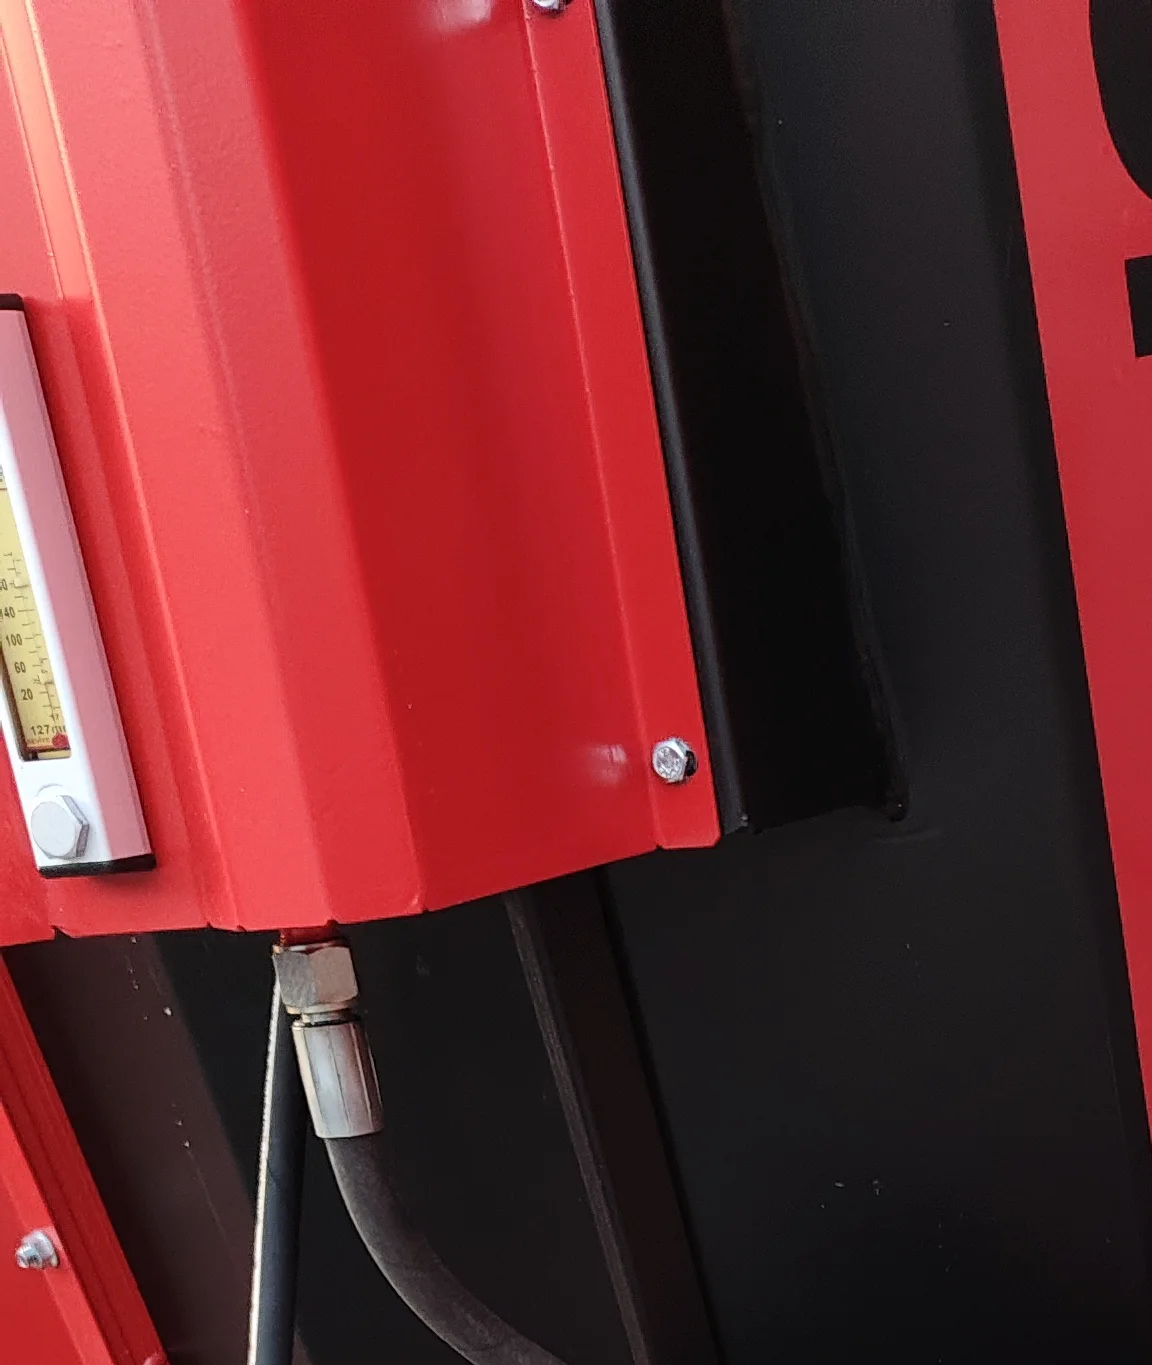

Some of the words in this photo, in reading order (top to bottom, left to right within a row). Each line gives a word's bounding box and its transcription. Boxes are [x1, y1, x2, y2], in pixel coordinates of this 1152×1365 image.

[5, 633, 23, 646] 100
[14, 661, 26, 674] 60
[21, 688, 34, 701] 20
